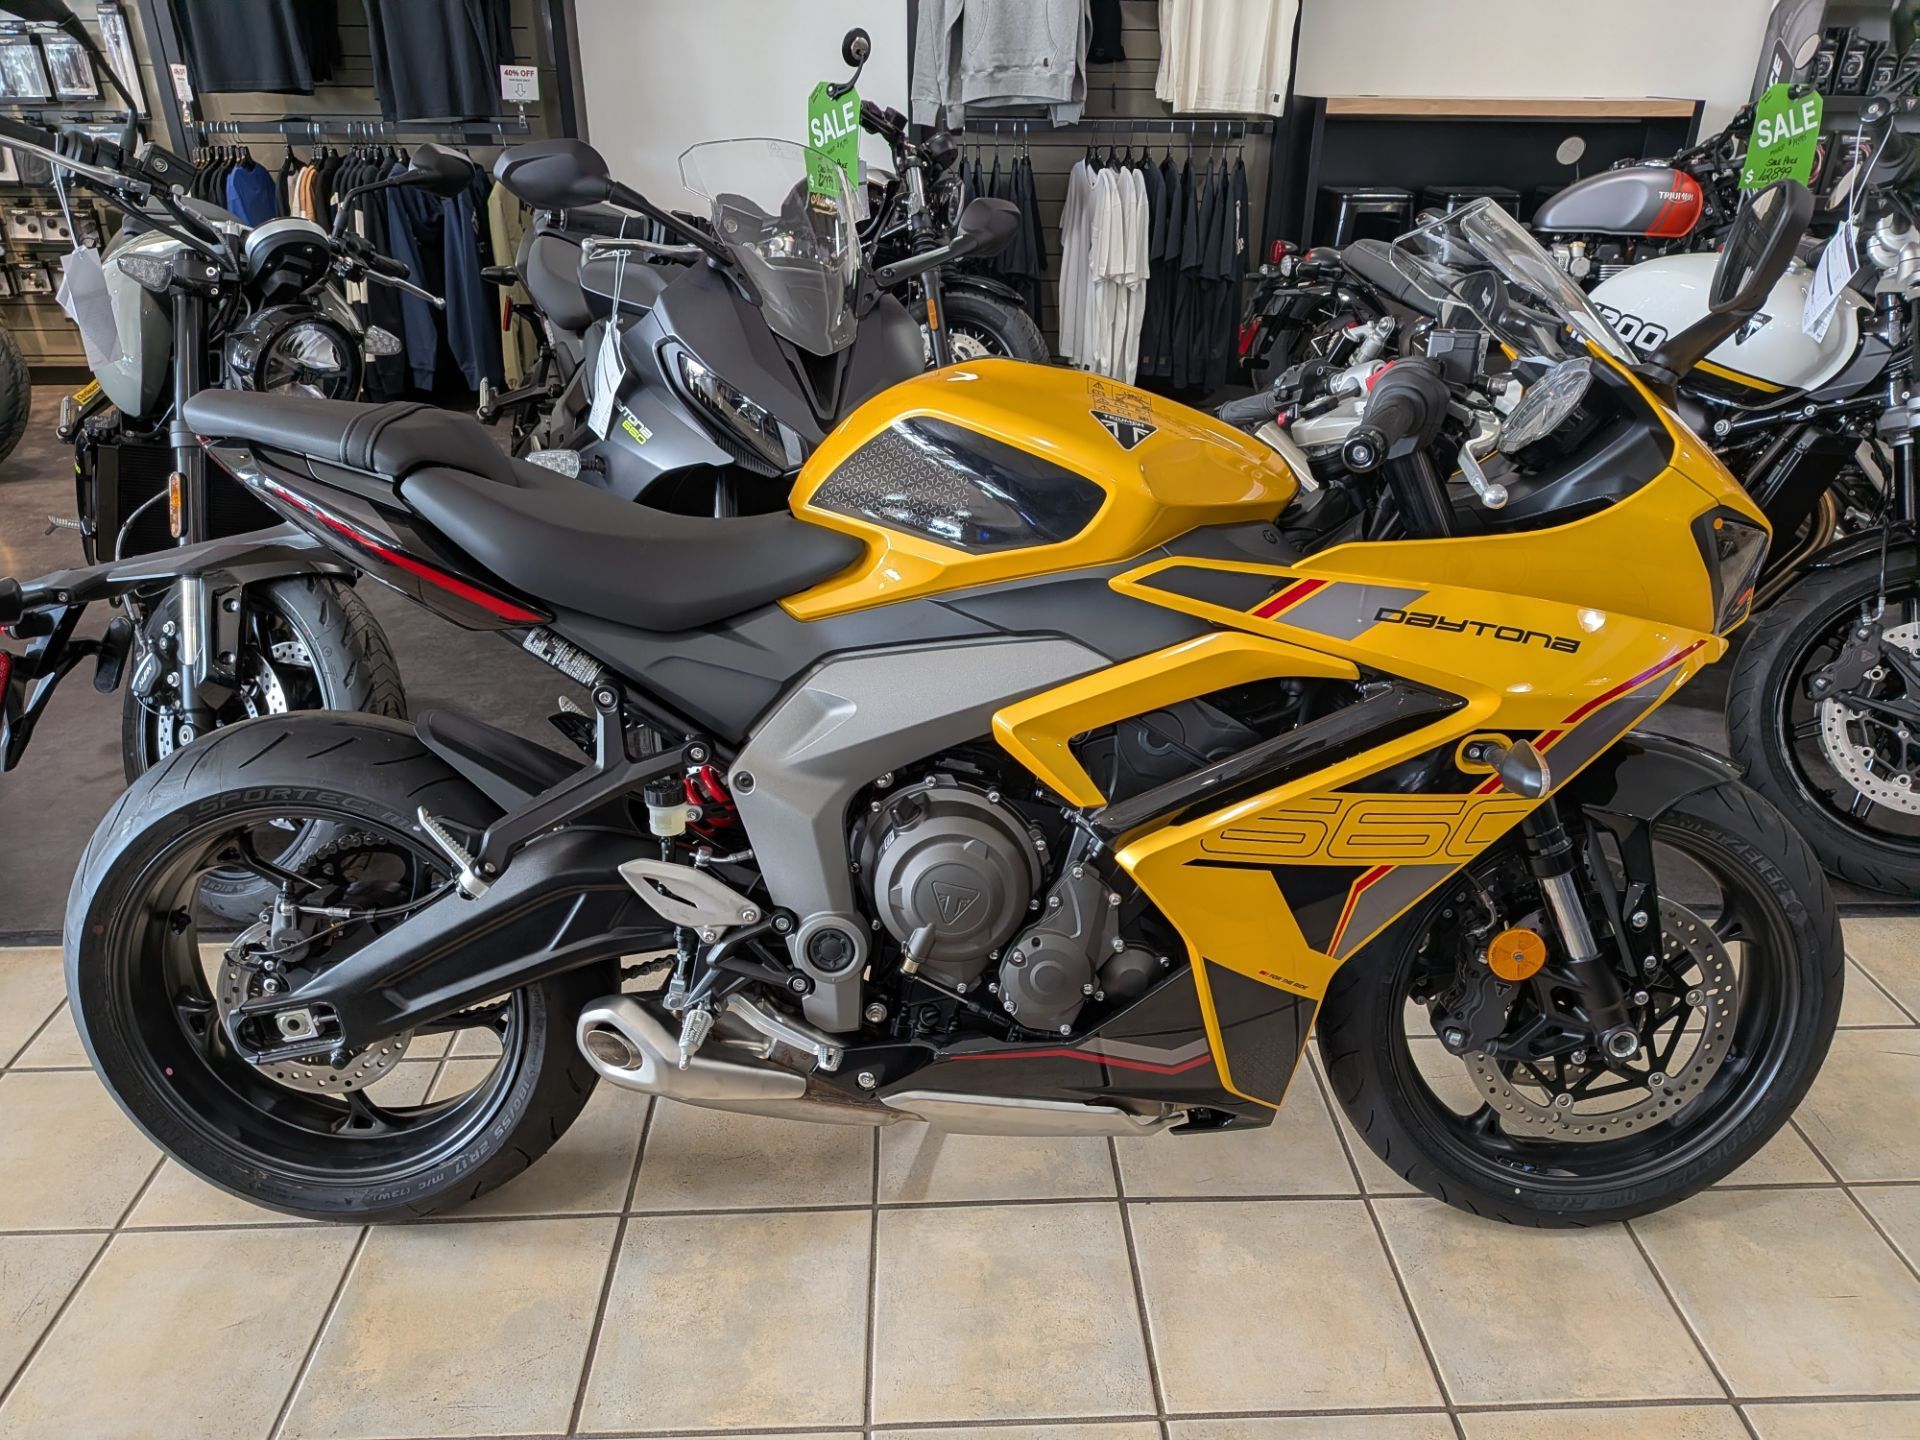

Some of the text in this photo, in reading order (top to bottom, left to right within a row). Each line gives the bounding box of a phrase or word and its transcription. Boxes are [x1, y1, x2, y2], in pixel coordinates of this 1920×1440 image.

[810, 100, 857, 149] SALE
[1756, 100, 1819, 149] SALE
[1658, 191, 1695, 201] TRIUMPH
[621, 419, 648, 446] 660
[1102, 413, 1146, 429] TRIUMPH
[195, 786, 367, 817] SPORTEC
